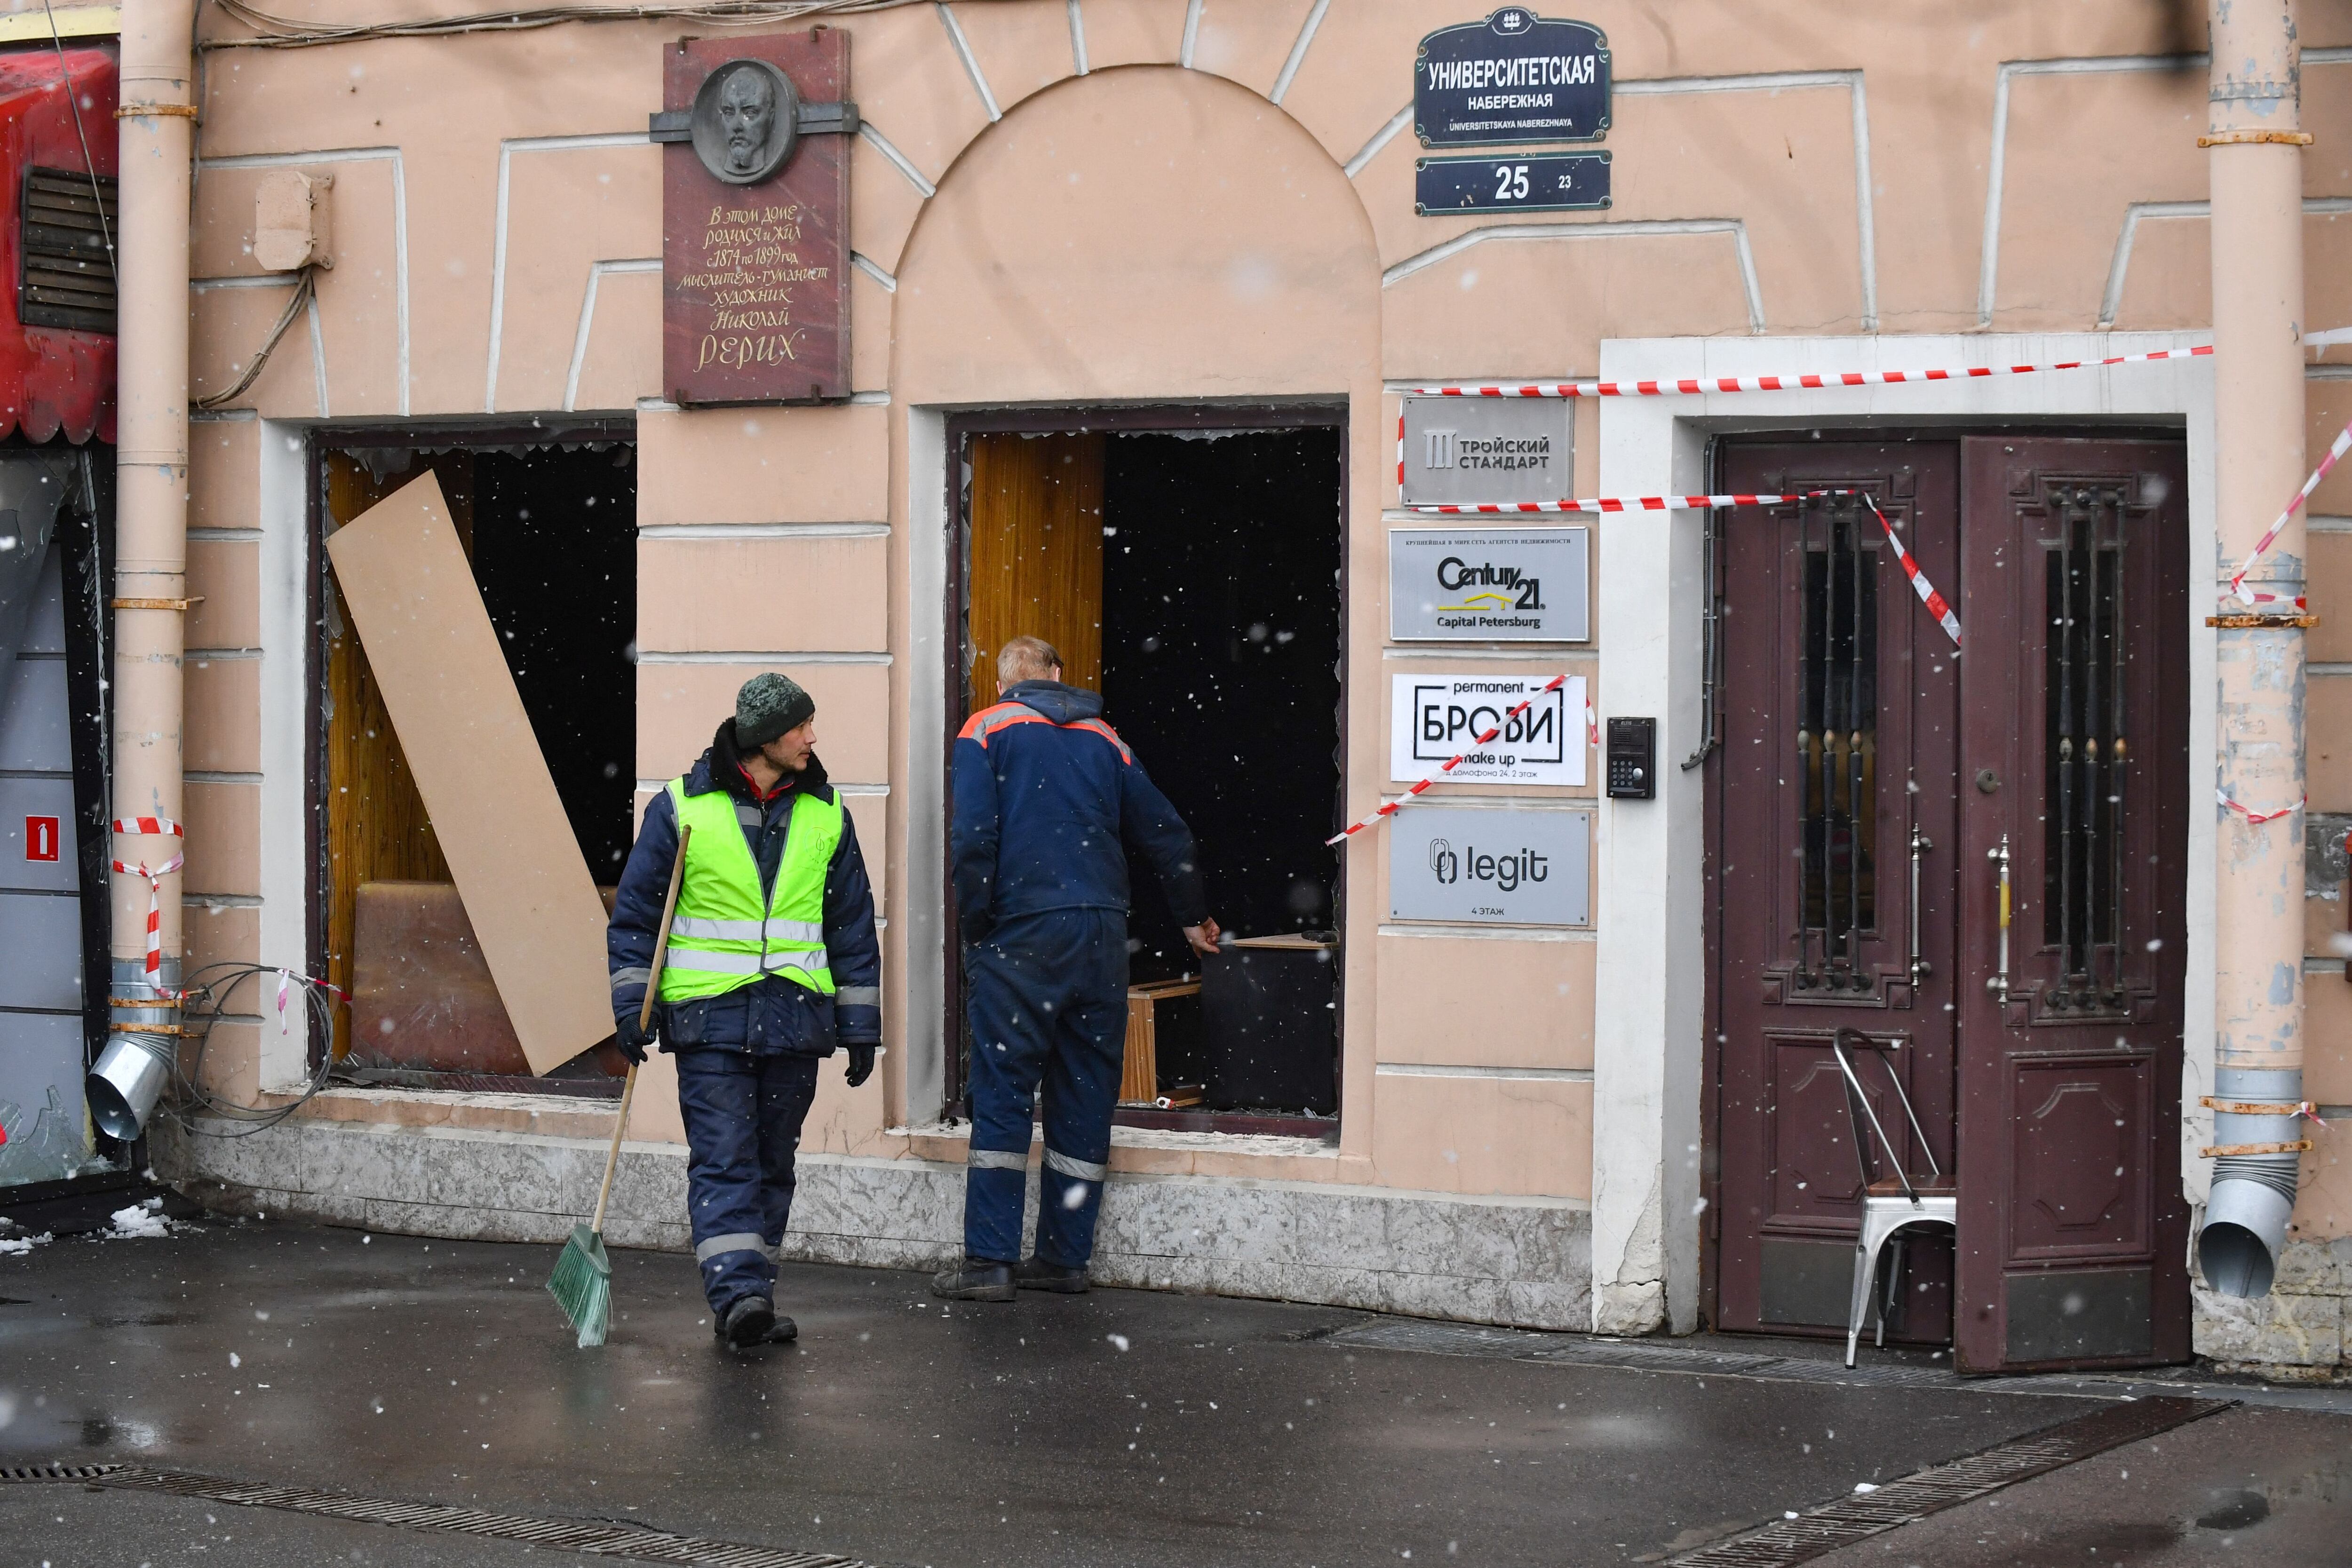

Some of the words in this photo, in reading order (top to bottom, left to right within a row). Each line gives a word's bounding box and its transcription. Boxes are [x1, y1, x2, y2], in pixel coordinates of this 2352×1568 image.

[1429, 55, 1595, 90] УНИВЕРСИТЕТСКАЯ
[1468, 94, 1553, 110] НАБЕРЕЖНАЯ
[1449, 120, 1516, 131] UNIVERSITETSKAYA
[1517, 118, 1572, 128] NABEREZHNAYA
[1495, 166, 1529, 199] 25
[1558, 175, 1572, 188] 23
[706, 206, 722, 226] В
[763, 231, 771, 241] и
[714, 249, 740, 267] 1874
[741, 255, 753, 265] по
[754, 246, 781, 268] 1899
[782, 253, 798, 265] год
[709, 287, 794, 307] художник
[710, 308, 790, 331] Николай
[1460, 436, 1549, 453] ТРОЙСКИЙ
[1459, 456, 1549, 470] СТАНДАРТ
[1438, 557, 1521, 590] Century
[1438, 617, 1476, 629] Capital
[1479, 617, 1541, 629] Petersburg
[1454, 682, 1524, 695] permanent
[1424, 705, 1552, 743] БРОВИ
[1461, 751, 1495, 764] make
[1499, 755, 1515, 767] up
[1467, 846, 1548, 891] legit
